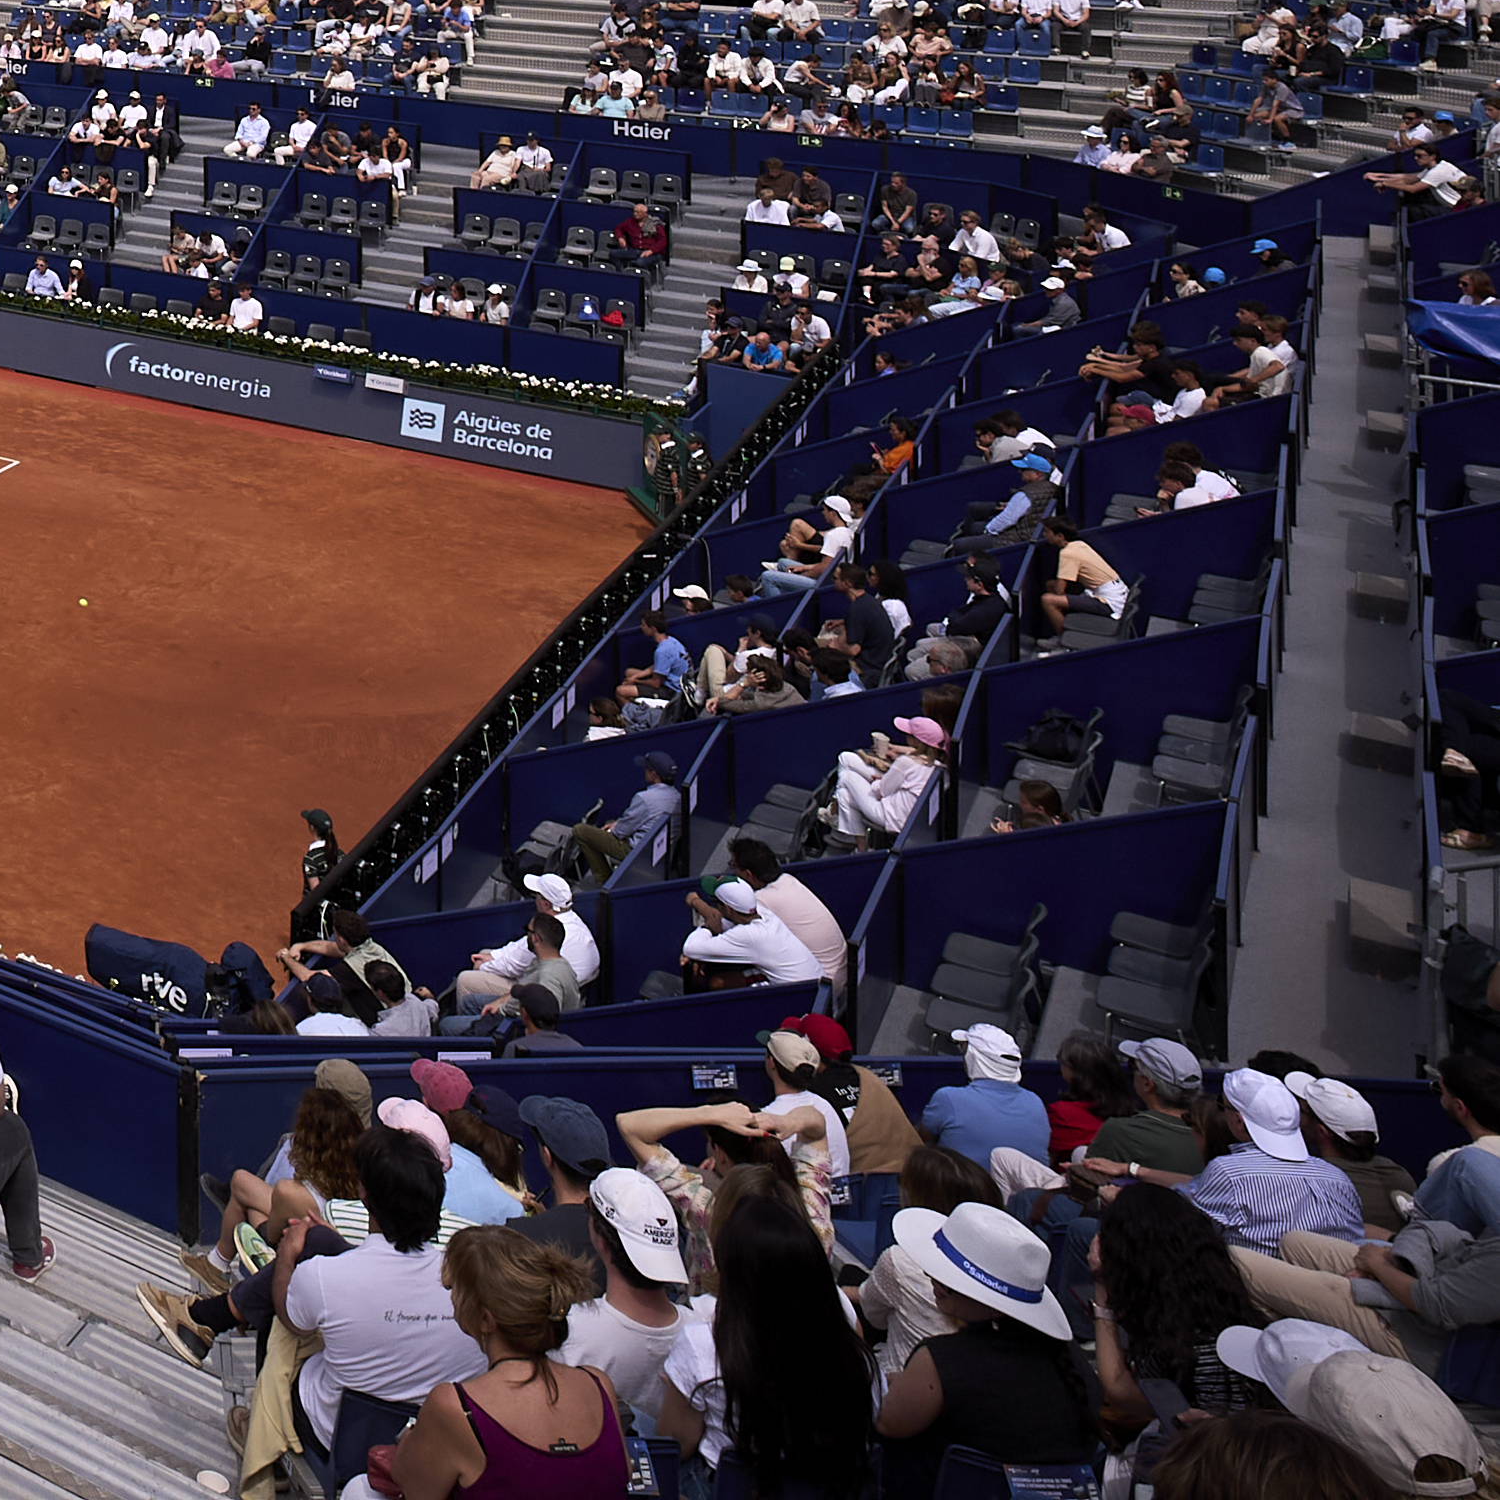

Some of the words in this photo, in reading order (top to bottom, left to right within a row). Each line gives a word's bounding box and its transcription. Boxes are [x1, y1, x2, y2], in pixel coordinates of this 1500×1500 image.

[613, 120, 672, 141] Haier
[127, 355, 272, 398] factorenergia
[323, 368, 348, 380] Occident
[452, 411, 522, 437] Aigües
[525, 423, 552, 442] de
[452, 429, 553, 461] Barcelona
[140, 971, 188, 1013] rtve
[968, 1266, 1009, 1295] Sabadell
